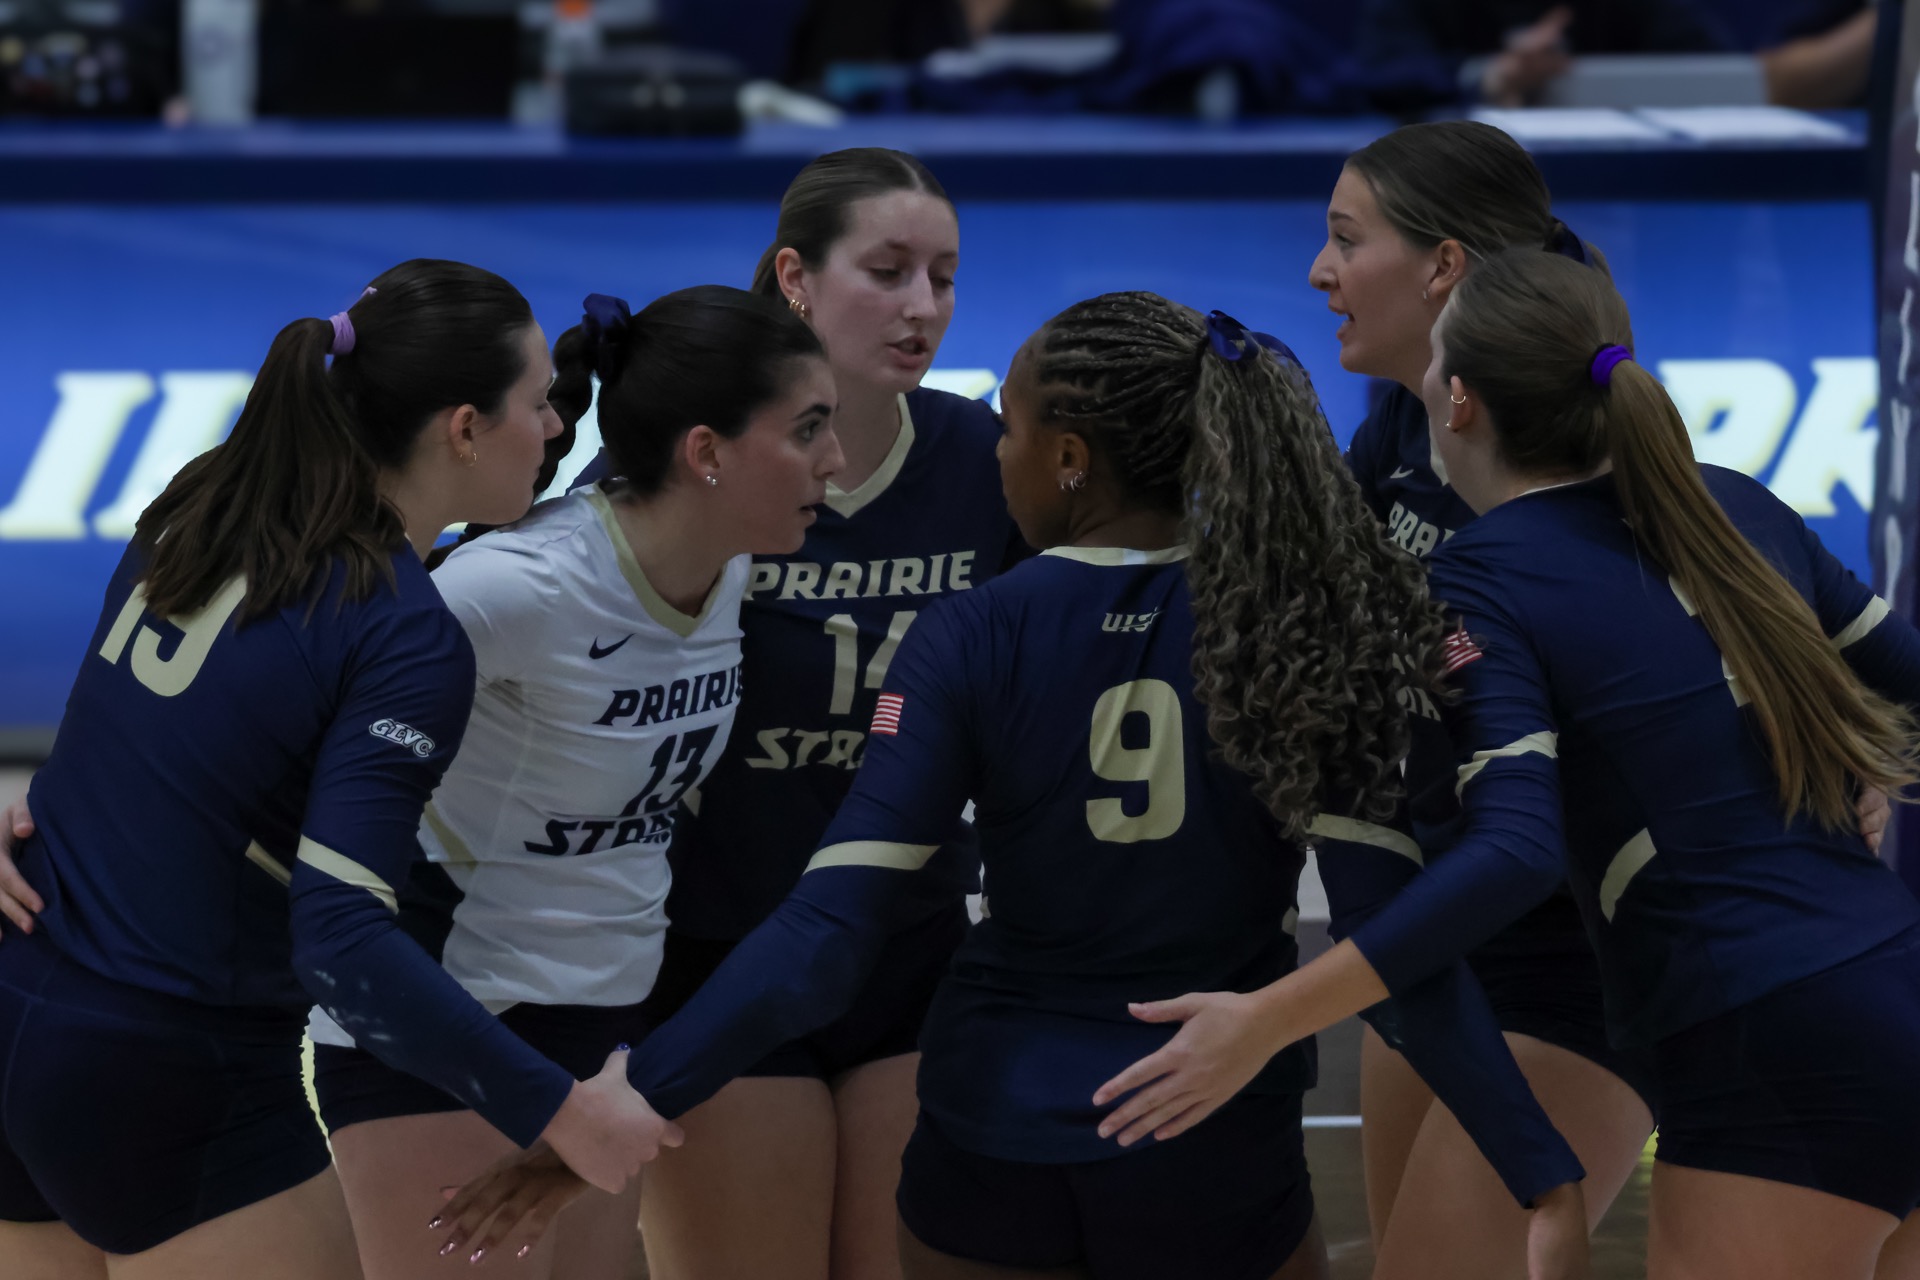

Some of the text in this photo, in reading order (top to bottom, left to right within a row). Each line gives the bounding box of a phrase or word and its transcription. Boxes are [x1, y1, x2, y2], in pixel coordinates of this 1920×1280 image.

[742, 550, 976, 601] PRAIRIE
[368, 718, 436, 757] GLVC
[744, 726, 866, 770] STA
[1086, 678, 1186, 843] 9
[618, 723, 720, 818] 13
